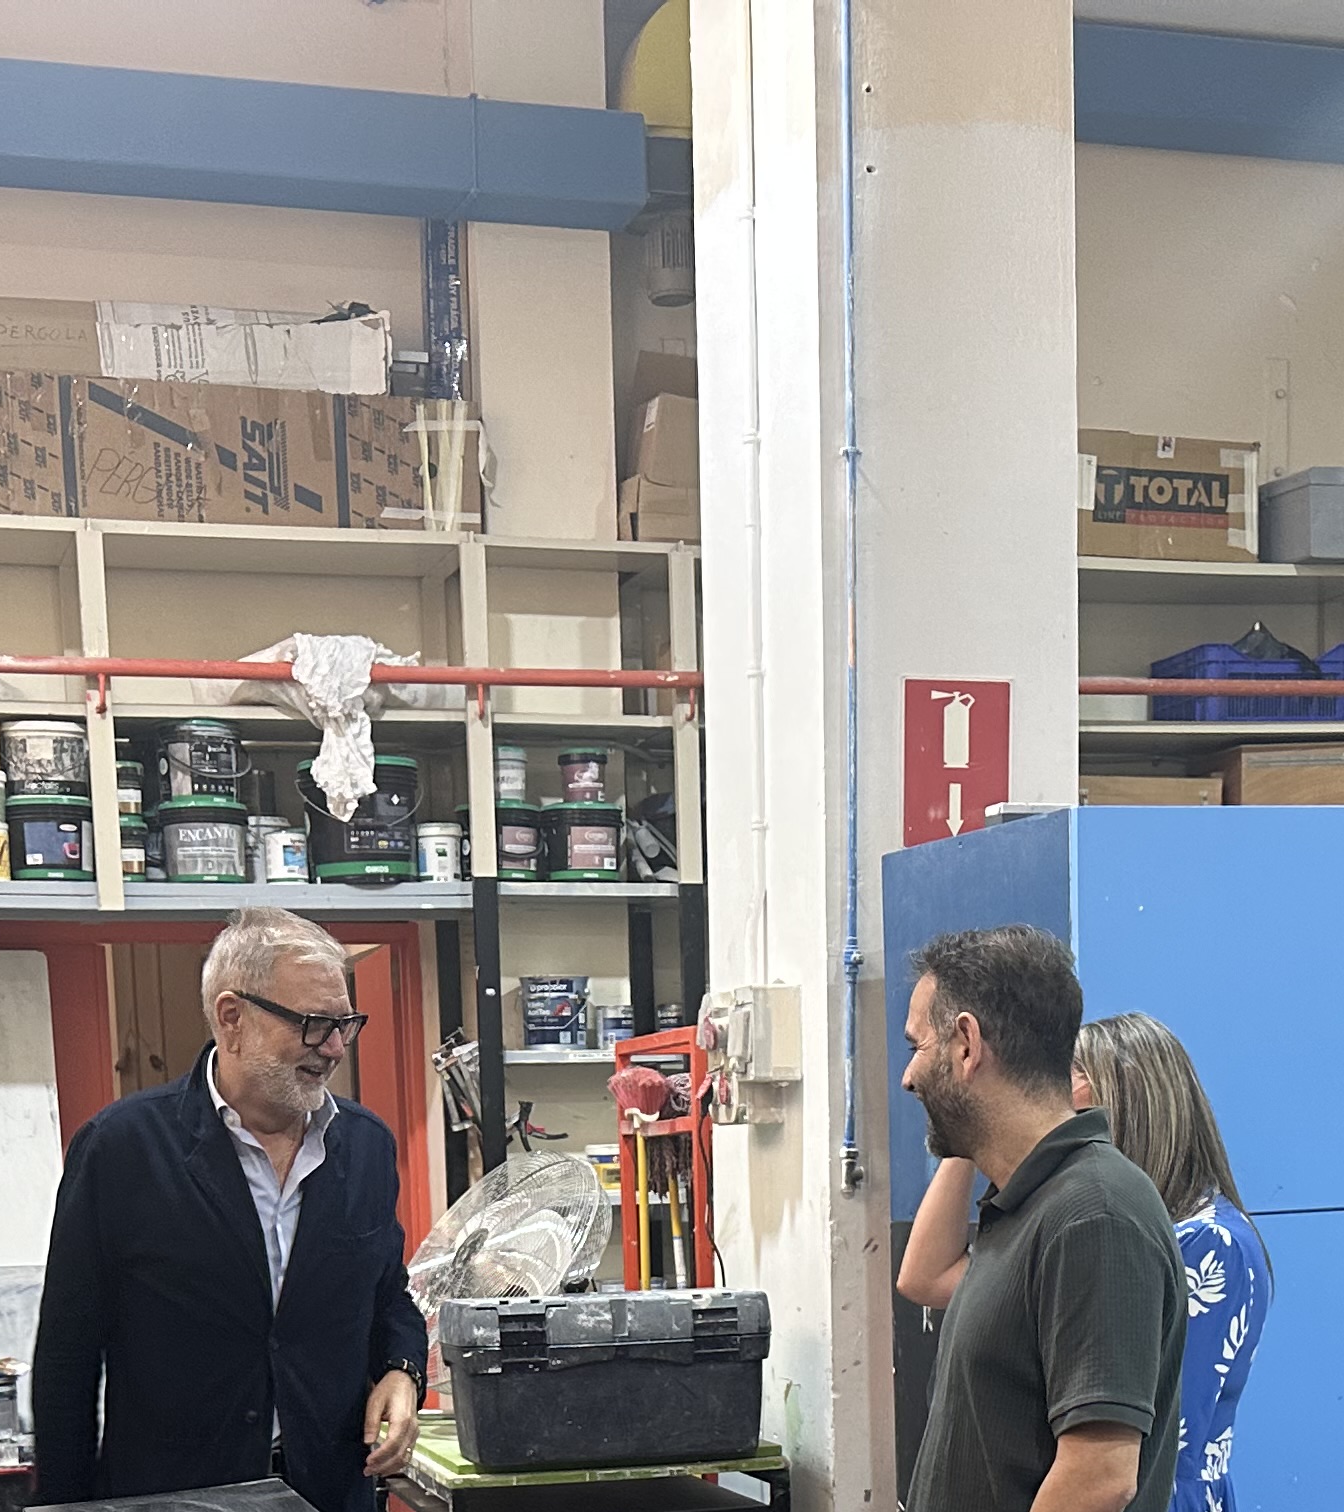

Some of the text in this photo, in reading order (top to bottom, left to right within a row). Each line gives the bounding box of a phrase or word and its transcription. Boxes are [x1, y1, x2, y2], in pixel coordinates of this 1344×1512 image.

[240, 416, 269, 512] SAIT
[1129, 476, 1226, 508] TOTAL
[178, 827, 237, 842] ENCANTO
